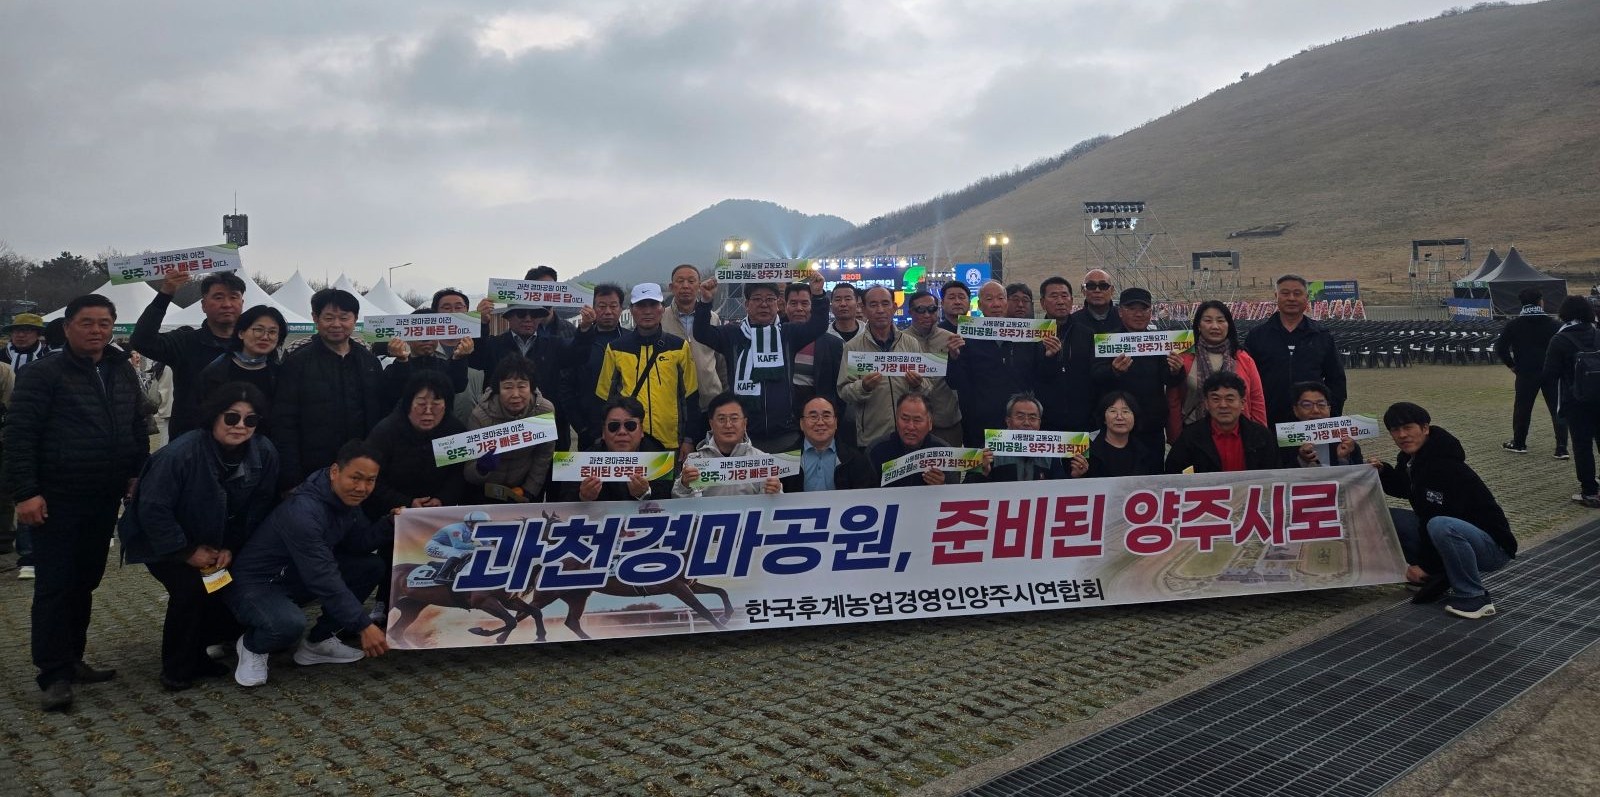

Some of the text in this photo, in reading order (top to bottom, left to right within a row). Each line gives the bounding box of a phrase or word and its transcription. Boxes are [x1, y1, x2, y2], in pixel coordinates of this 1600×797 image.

[143, 257, 158, 265] 과천
[160, 253, 189, 263] 경마공원
[122, 268, 151, 279] 양주가
[154, 264, 175, 275] 가장
[178, 262, 200, 272] 빠른
[718, 270, 756, 279] 경마공원은
[758, 270, 782, 279] 양주가
[498, 291, 521, 300] 양주가
[524, 292, 542, 301] 가장
[544, 292, 561, 302] 빠른
[375, 328, 401, 338] 양주가
[404, 326, 424, 337] 가장
[426, 326, 445, 335] 빠른
[960, 326, 997, 336] 경마공원은
[999, 329, 1024, 338] 양주가
[1098, 344, 1136, 353] 경마공원은
[1137, 343, 1162, 352] 양주가
[857, 363, 879, 372] 양주가
[880, 364, 897, 372] 가장
[738, 382, 756, 390] KAFF
[466, 424, 524, 443] 과천 경마공원 이전
[1288, 433, 1311, 443] 양주가
[1313, 430, 1329, 440] 가장
[447, 431, 547, 460] 양주가 가장 빠른 답이다.
[988, 442, 1027, 452] 경마공원은
[1029, 442, 1055, 453] 양주가
[580, 466, 611, 477] 준비된
[701, 471, 726, 482] 양주가
[728, 469, 747, 480] 가장
[750, 468, 768, 478] 빠른
[884, 462, 917, 481] 경마공원은
[919, 459, 945, 468] 양주가
[454, 482, 1342, 591] 과천경마공원, 준비된 양주시로
[745, 578, 1105, 624] 한국후계농업경영인양주시연합회
